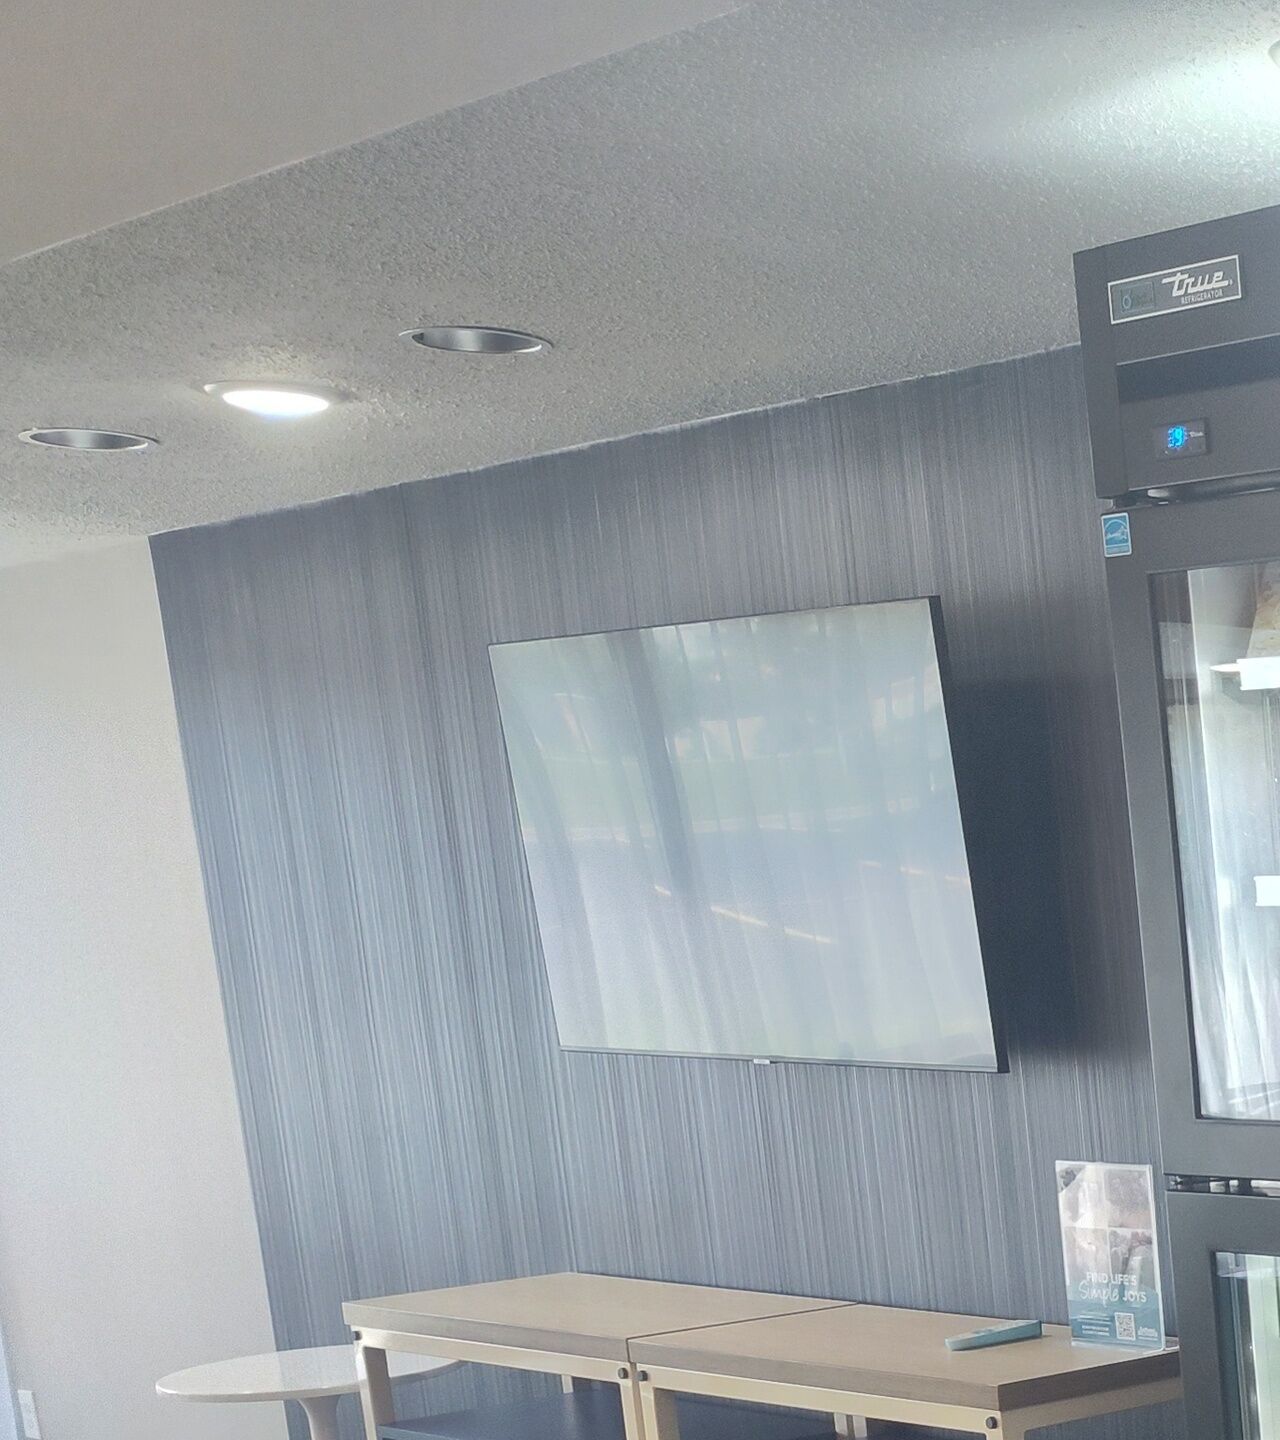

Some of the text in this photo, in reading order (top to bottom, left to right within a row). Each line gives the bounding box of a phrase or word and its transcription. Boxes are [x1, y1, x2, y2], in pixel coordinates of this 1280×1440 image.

[1180, 288, 1223, 305] REFRIGERATOR
[1086, 1271, 1137, 1286] FIND LIFE'S
[1078, 1280, 1147, 1308] Simple JOYS
